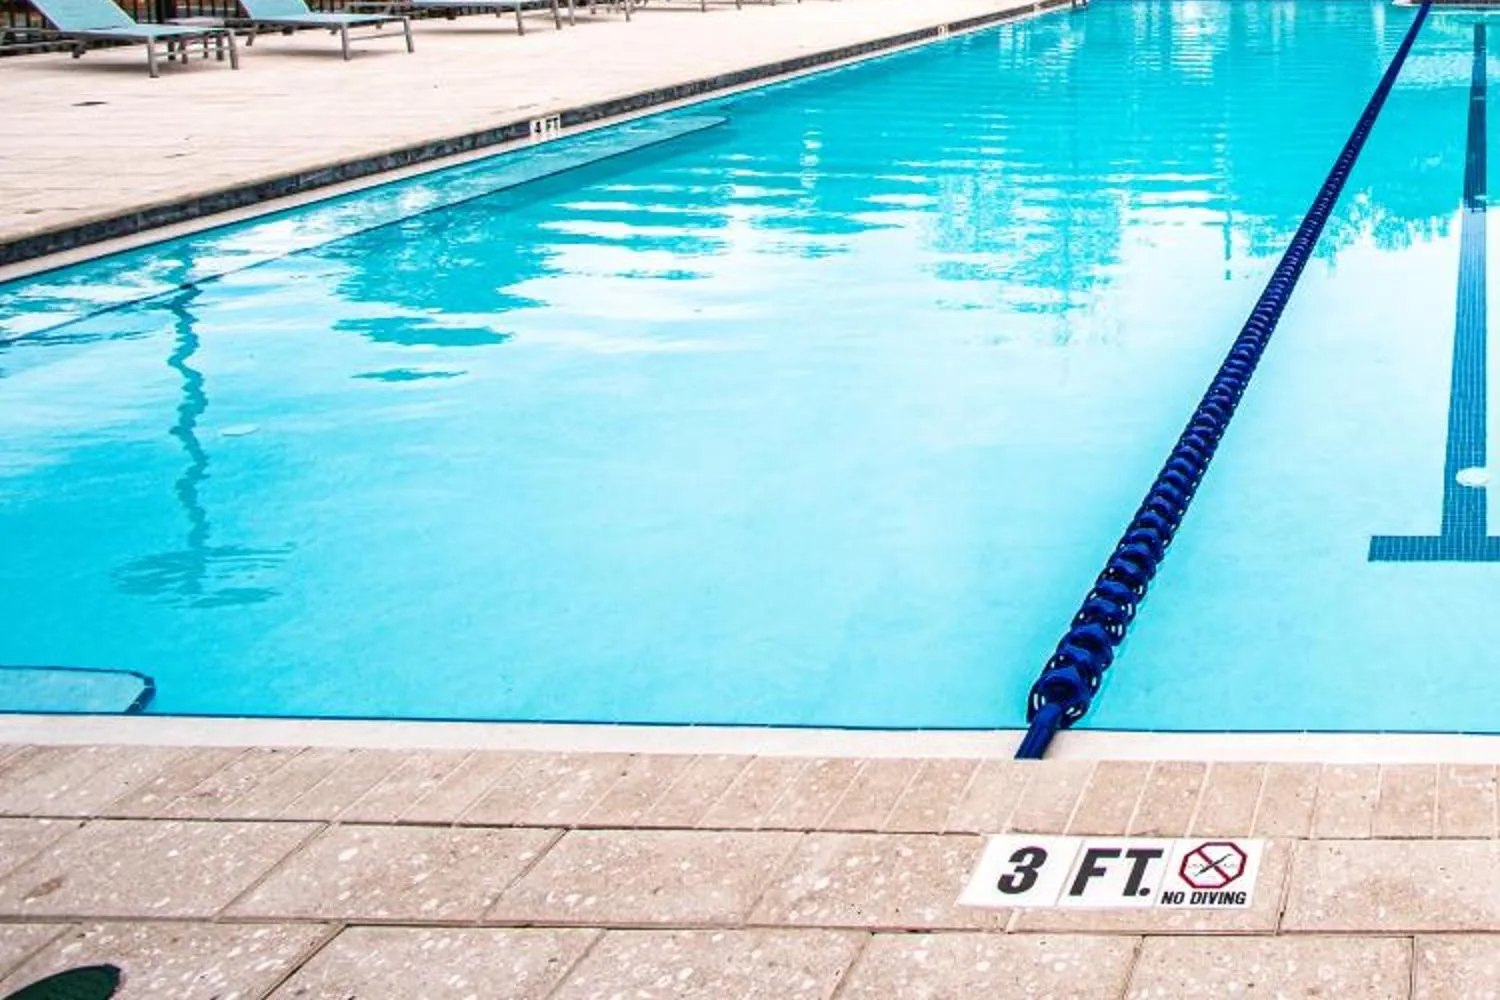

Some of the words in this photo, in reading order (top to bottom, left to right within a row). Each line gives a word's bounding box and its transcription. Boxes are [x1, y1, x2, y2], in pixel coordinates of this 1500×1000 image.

[997, 846, 1048, 895] 3
[1069, 848, 1164, 897] FT.
[1161, 891, 1185, 905] NO
[1189, 891, 1247, 905] DIVING
